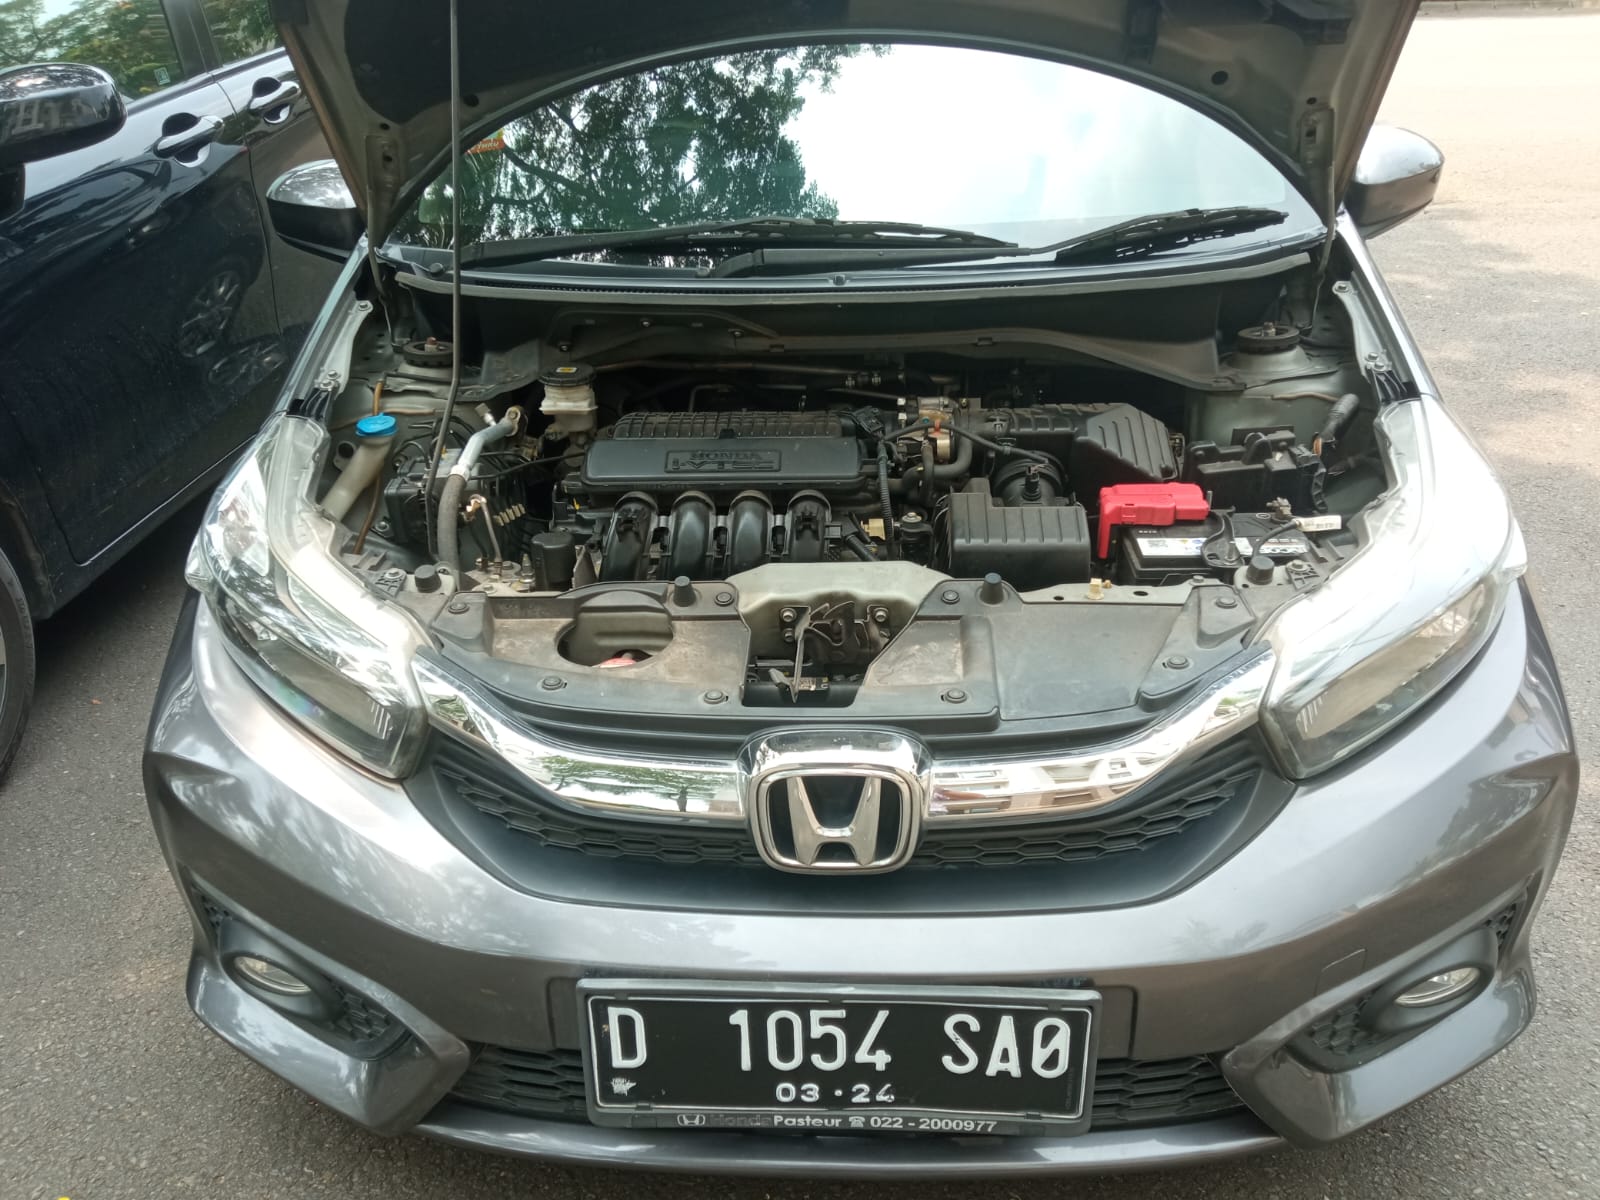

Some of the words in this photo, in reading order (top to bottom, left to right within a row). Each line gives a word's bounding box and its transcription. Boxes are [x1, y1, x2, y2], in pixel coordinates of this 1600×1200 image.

[607, 1006, 647, 1069] D
[729, 1009, 892, 1072] 1054
[775, 1082, 820, 1103] 03
[773, 1115, 843, 1127] Pasteur
[870, 1116, 904, 1129] 022
[919, 1118, 998, 1133] 2000977
